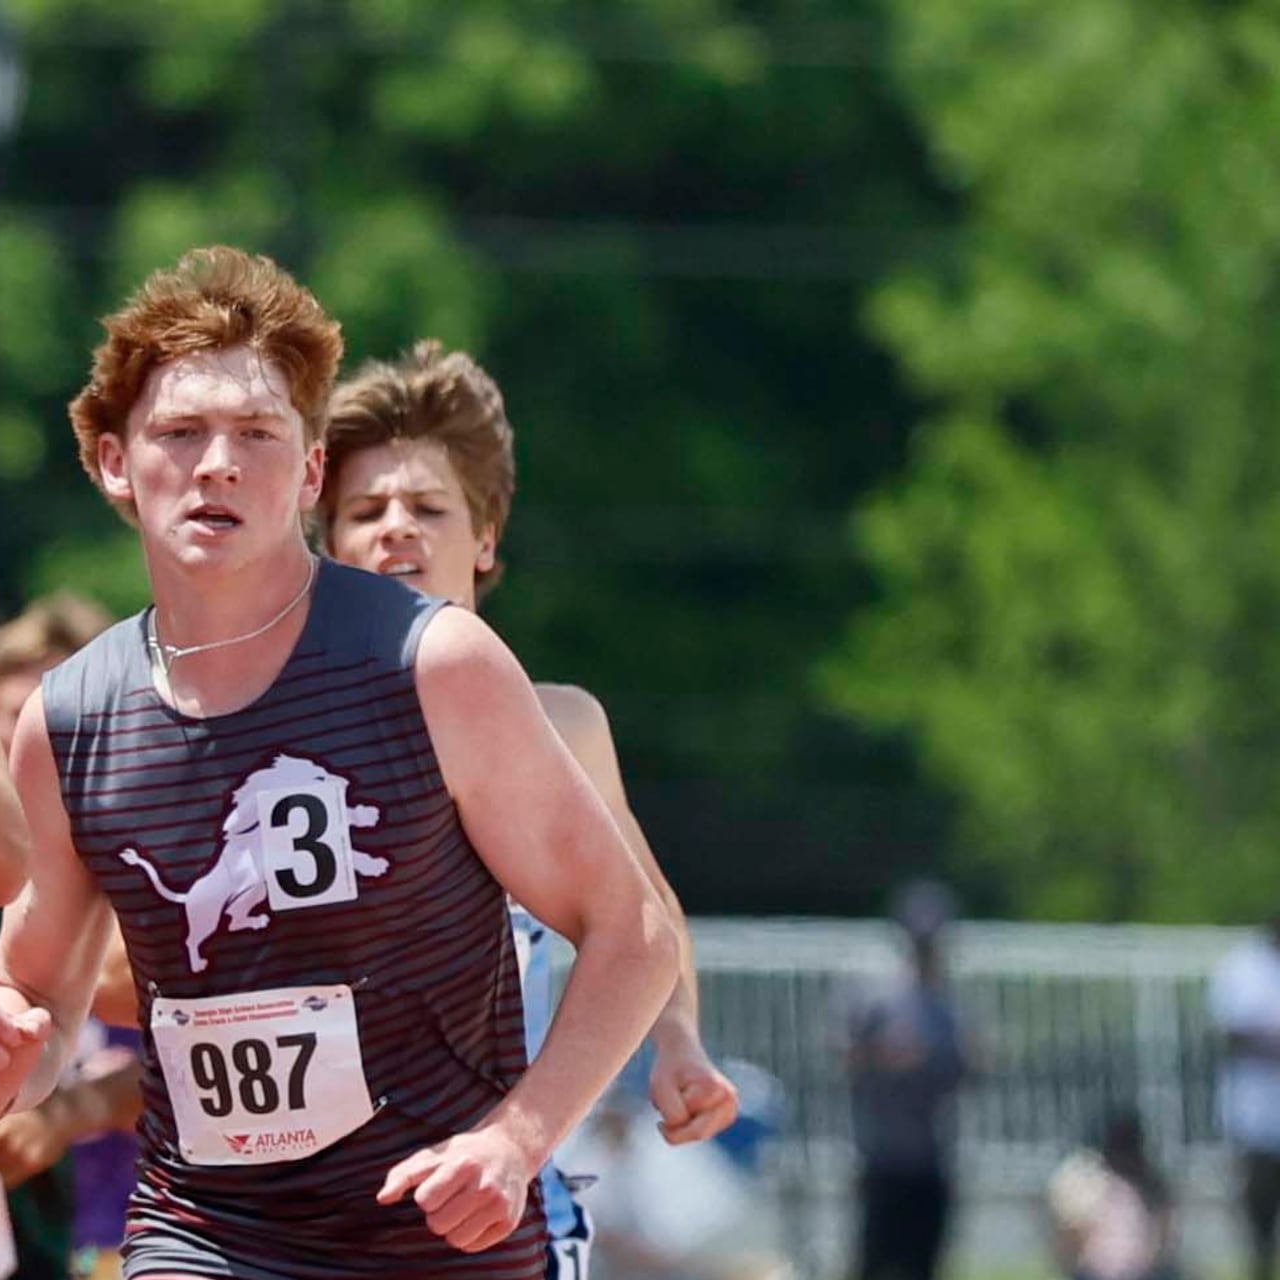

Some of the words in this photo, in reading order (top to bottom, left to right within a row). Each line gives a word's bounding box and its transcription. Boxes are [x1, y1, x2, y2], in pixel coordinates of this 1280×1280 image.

[271, 794, 337, 898] 3
[191, 1032, 317, 1117] 987
[256, 1128, 316, 1147] ATLANTA
